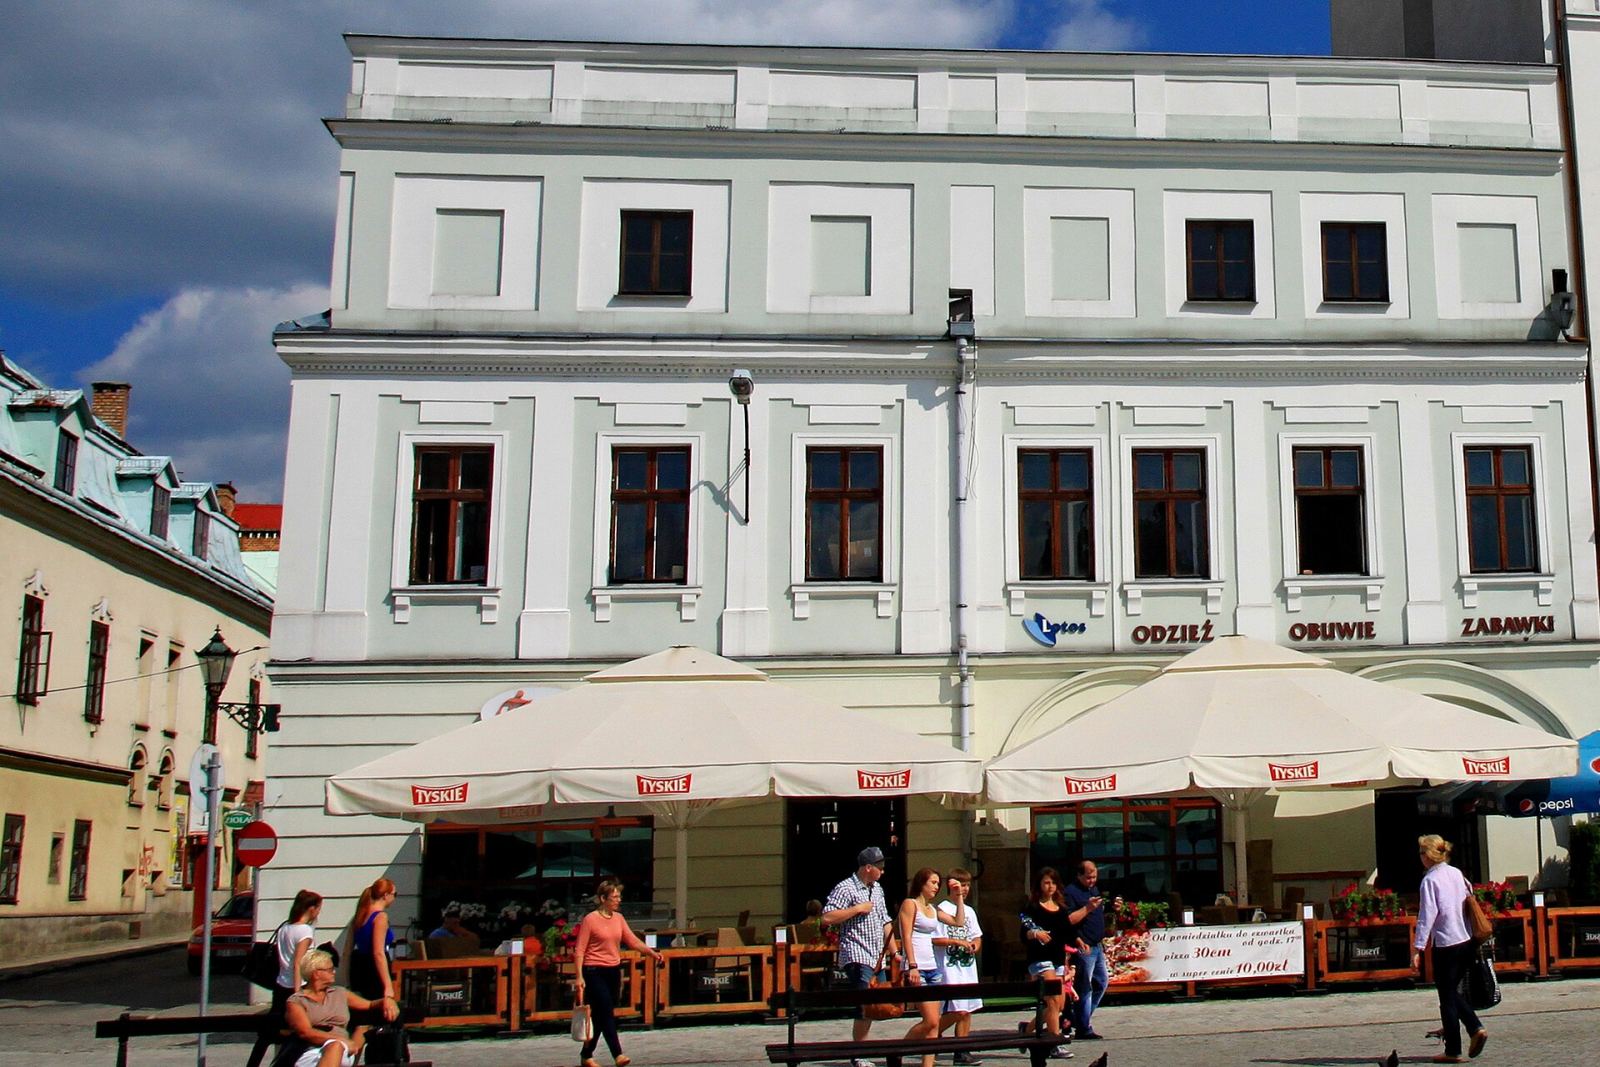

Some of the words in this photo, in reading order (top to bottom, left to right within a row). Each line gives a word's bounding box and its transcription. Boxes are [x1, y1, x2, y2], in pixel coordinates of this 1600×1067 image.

[1042, 618, 1087, 634] Lotos
[1289, 620, 1376, 640] OBUWIE
[1461, 615, 1554, 637] ZABAWKI
[1272, 765, 1316, 779] TYSKIE
[1465, 760, 1508, 774] TYSKIE
[640, 778, 688, 794] TYSKIE
[861, 773, 907, 788] TYSKIE
[1067, 777, 1114, 793] TYSKIE
[415, 787, 464, 804] TYSKIE
[1538, 798, 1574, 812] pepsi
[1152, 932, 1166, 942] Od
[1236, 929, 1248, 938] do
[1242, 938, 1254, 947] od
[1164, 952, 1190, 962] pizza
[1193, 947, 1232, 959] 30cm
[702, 976, 730, 985] TYSKIE
[833, 970, 848, 979] TYS
[1182, 970, 1208, 978] super
[435, 990, 464, 1000] TYSKIE
